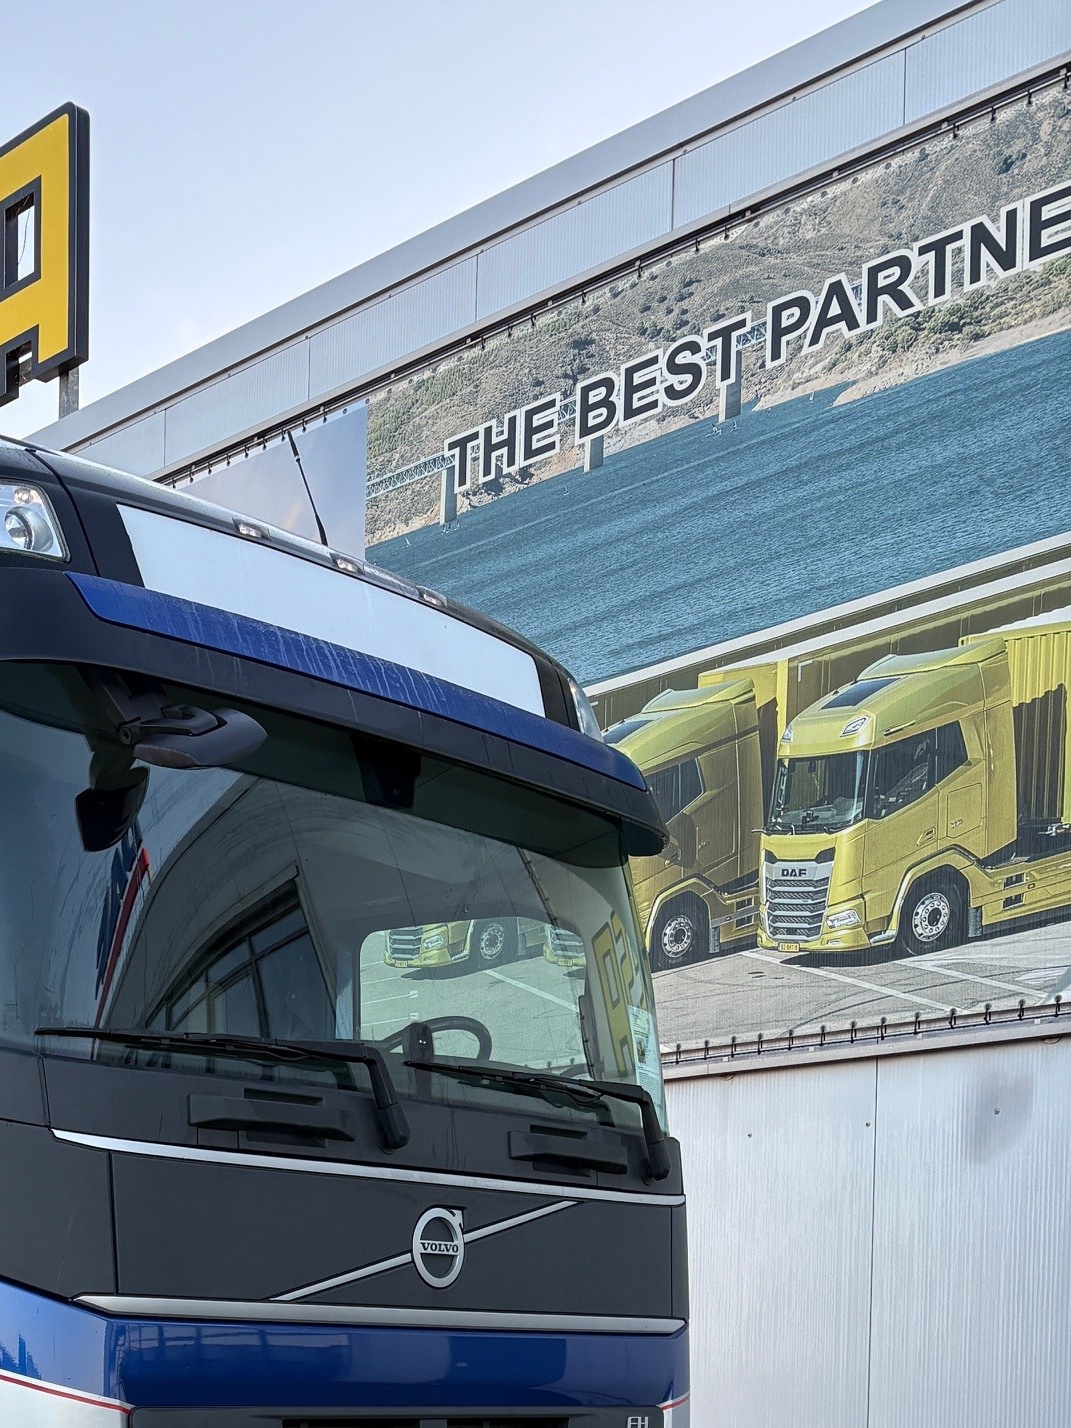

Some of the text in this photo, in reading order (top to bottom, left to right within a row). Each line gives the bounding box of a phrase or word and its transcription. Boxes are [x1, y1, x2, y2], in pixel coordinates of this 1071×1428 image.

[445, 183, 1071, 491] THE BEST PARTNE
[781, 868, 807, 877] DAF
[420, 1242, 459, 1254] VOLVO
